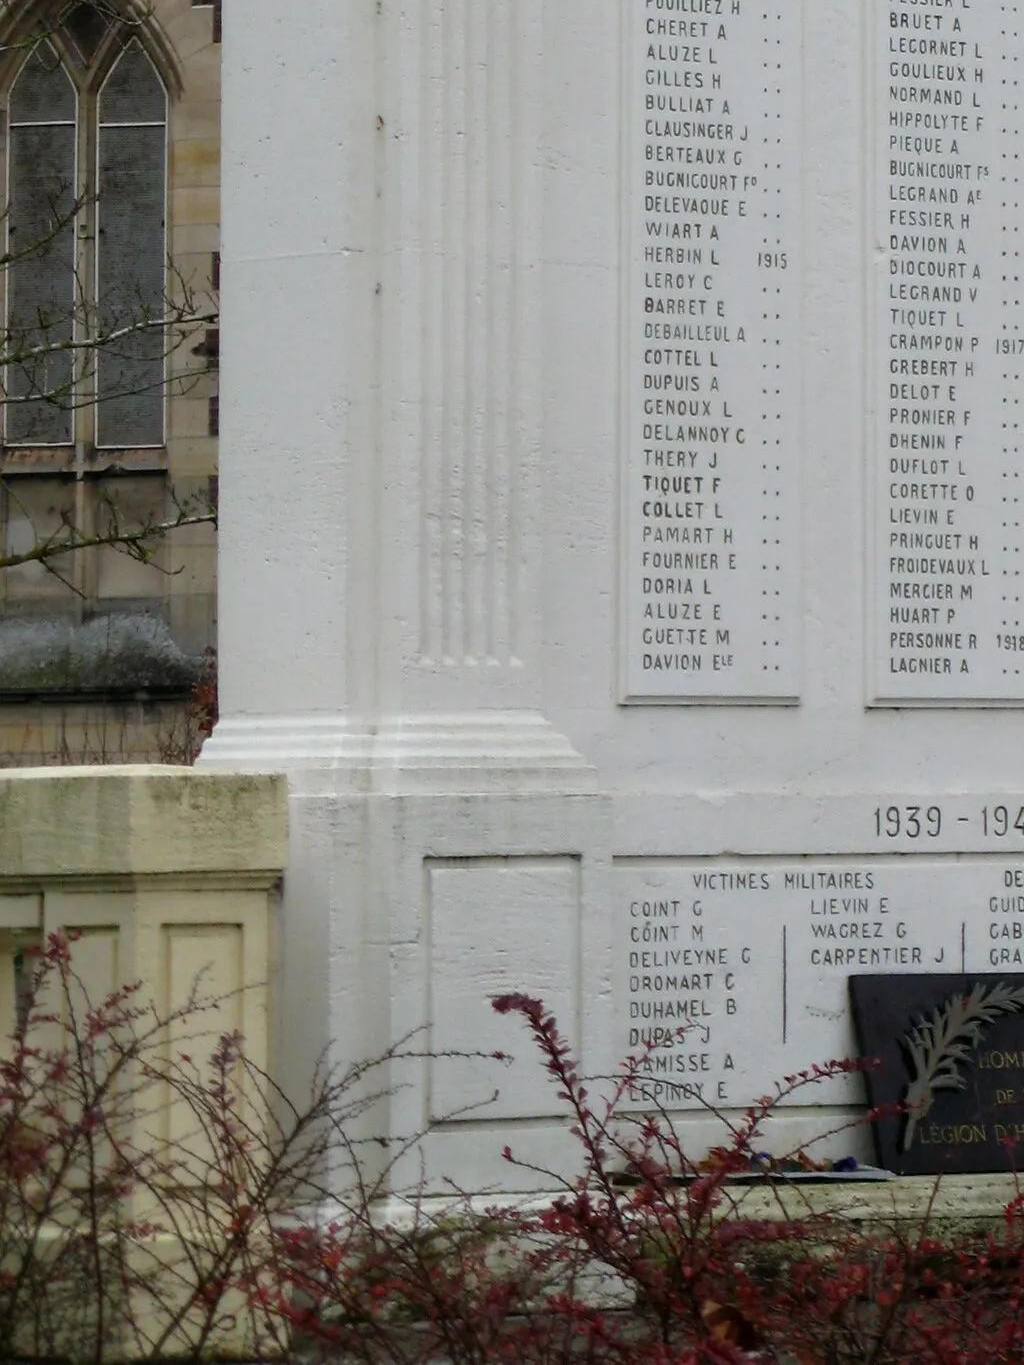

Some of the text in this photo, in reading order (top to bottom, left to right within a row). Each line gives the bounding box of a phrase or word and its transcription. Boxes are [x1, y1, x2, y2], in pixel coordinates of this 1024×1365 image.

[730, 0, 741, 16] H
[645, 17, 727, 41] CHERET A
[888, 36, 984, 60] LECORNET L
[644, 68, 722, 90] GILLES H
[644, 93, 731, 116] BULLIAT A
[889, 85, 982, 109] NORMAND L
[888, 110, 985, 132] HIPPOLYTE F
[644, 144, 743, 167] BERTEAUX G
[889, 208, 970, 231] FESSIER H
[645, 221, 720, 241] WIART A
[644, 246, 787, 269] HERBIN L 1915
[644, 271, 713, 291] LEROY C
[889, 333, 1024, 354] CRAMPON P 1917
[643, 348, 719, 368] COTTEL L
[889, 382, 957, 403] DELOT E
[889, 407, 971, 427] PRONIER F
[642, 423, 746, 445] DELANNOY C
[889, 457, 967, 476] DUFLOT L
[642, 525, 734, 545] PAMART H
[889, 556, 991, 577] FROIDEVAUX L
[889, 631, 963, 650] PERSONNE
[968, 633, 978, 650] R
[874, 806, 941, 837] 1939
[693, 872, 874, 889] VICTIMES MILITAIRES
[630, 901, 702, 917] COINT G
[811, 898, 889, 915] LIEVIN E
[631, 926, 703, 942] COINT M
[811, 922, 907, 938] WAGREZ G
[630, 949, 727, 967] DELIVEYNE
[811, 947, 944, 966] CARPENTIER J
[630, 974, 736, 992] DROMART C
[630, 1000, 737, 1019] DUHAMEL B
[630, 1027, 710, 1046] DUPAS J
[724, 1053, 734, 1070] A
[718, 1082, 727, 1098] E
[997, 1090, 1015, 1104] DE
